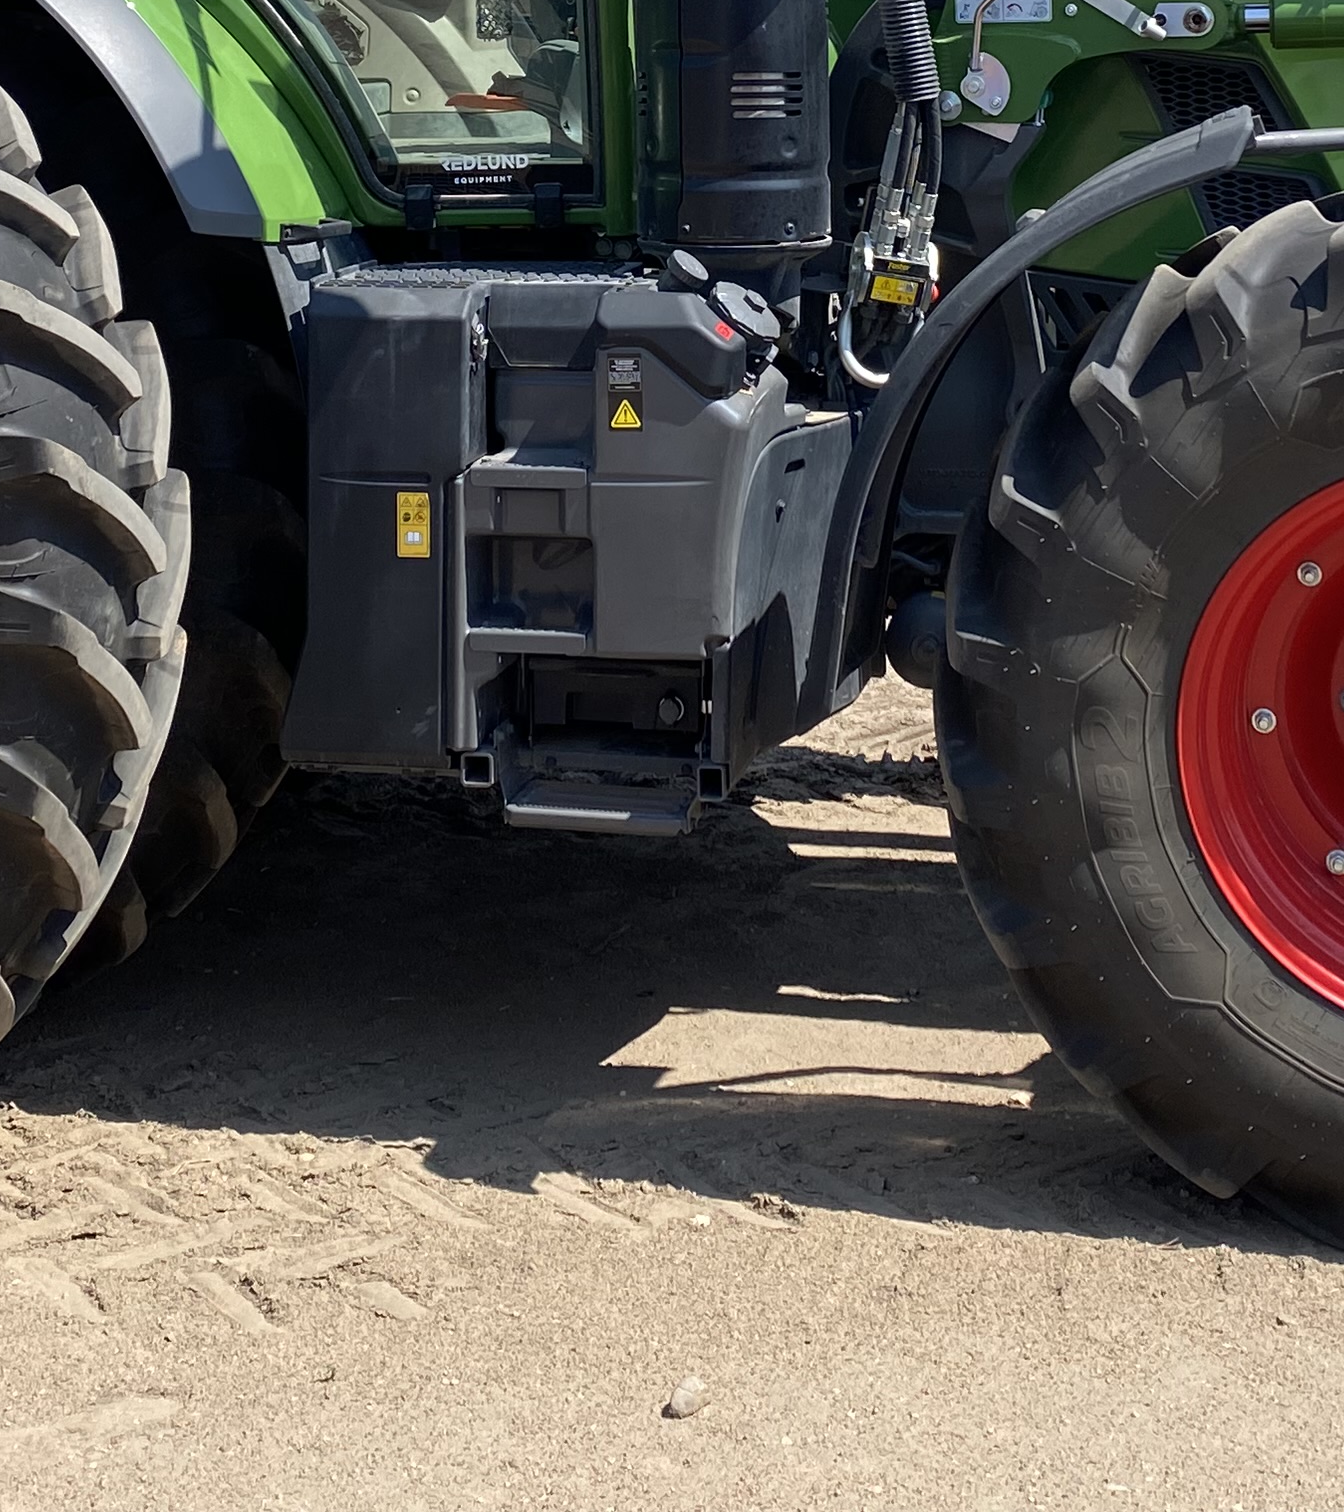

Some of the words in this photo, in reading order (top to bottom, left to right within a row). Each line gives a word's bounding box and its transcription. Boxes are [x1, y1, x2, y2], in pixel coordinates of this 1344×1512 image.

[439, 154, 529, 171] REDLUND
[454, 175, 513, 184] EQUIPMENT
[1080, 705, 1144, 763] 2
[1094, 762, 1200, 955] AGRIBIB
